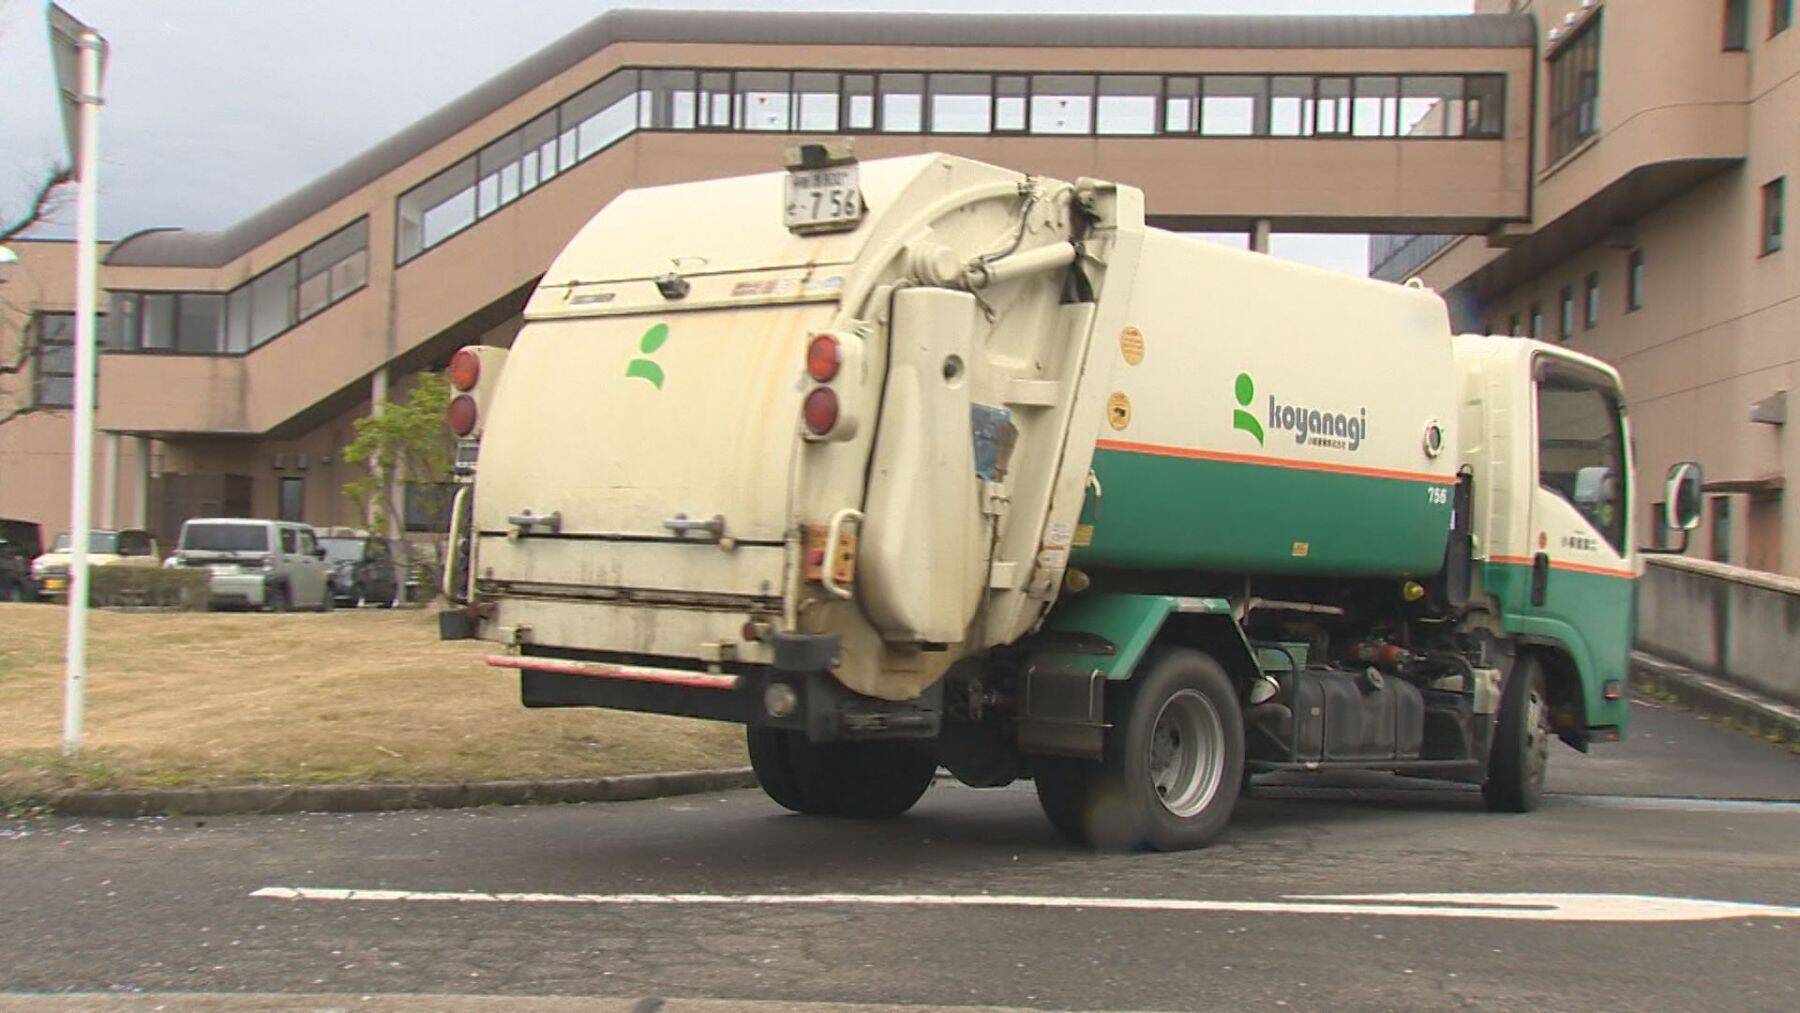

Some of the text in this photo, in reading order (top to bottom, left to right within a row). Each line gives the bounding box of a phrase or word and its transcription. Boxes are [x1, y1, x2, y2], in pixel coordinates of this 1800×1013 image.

[810, 189, 855, 219] 756
[1269, 394, 1365, 451] koyanagi
[1428, 487, 1447, 504] 756
